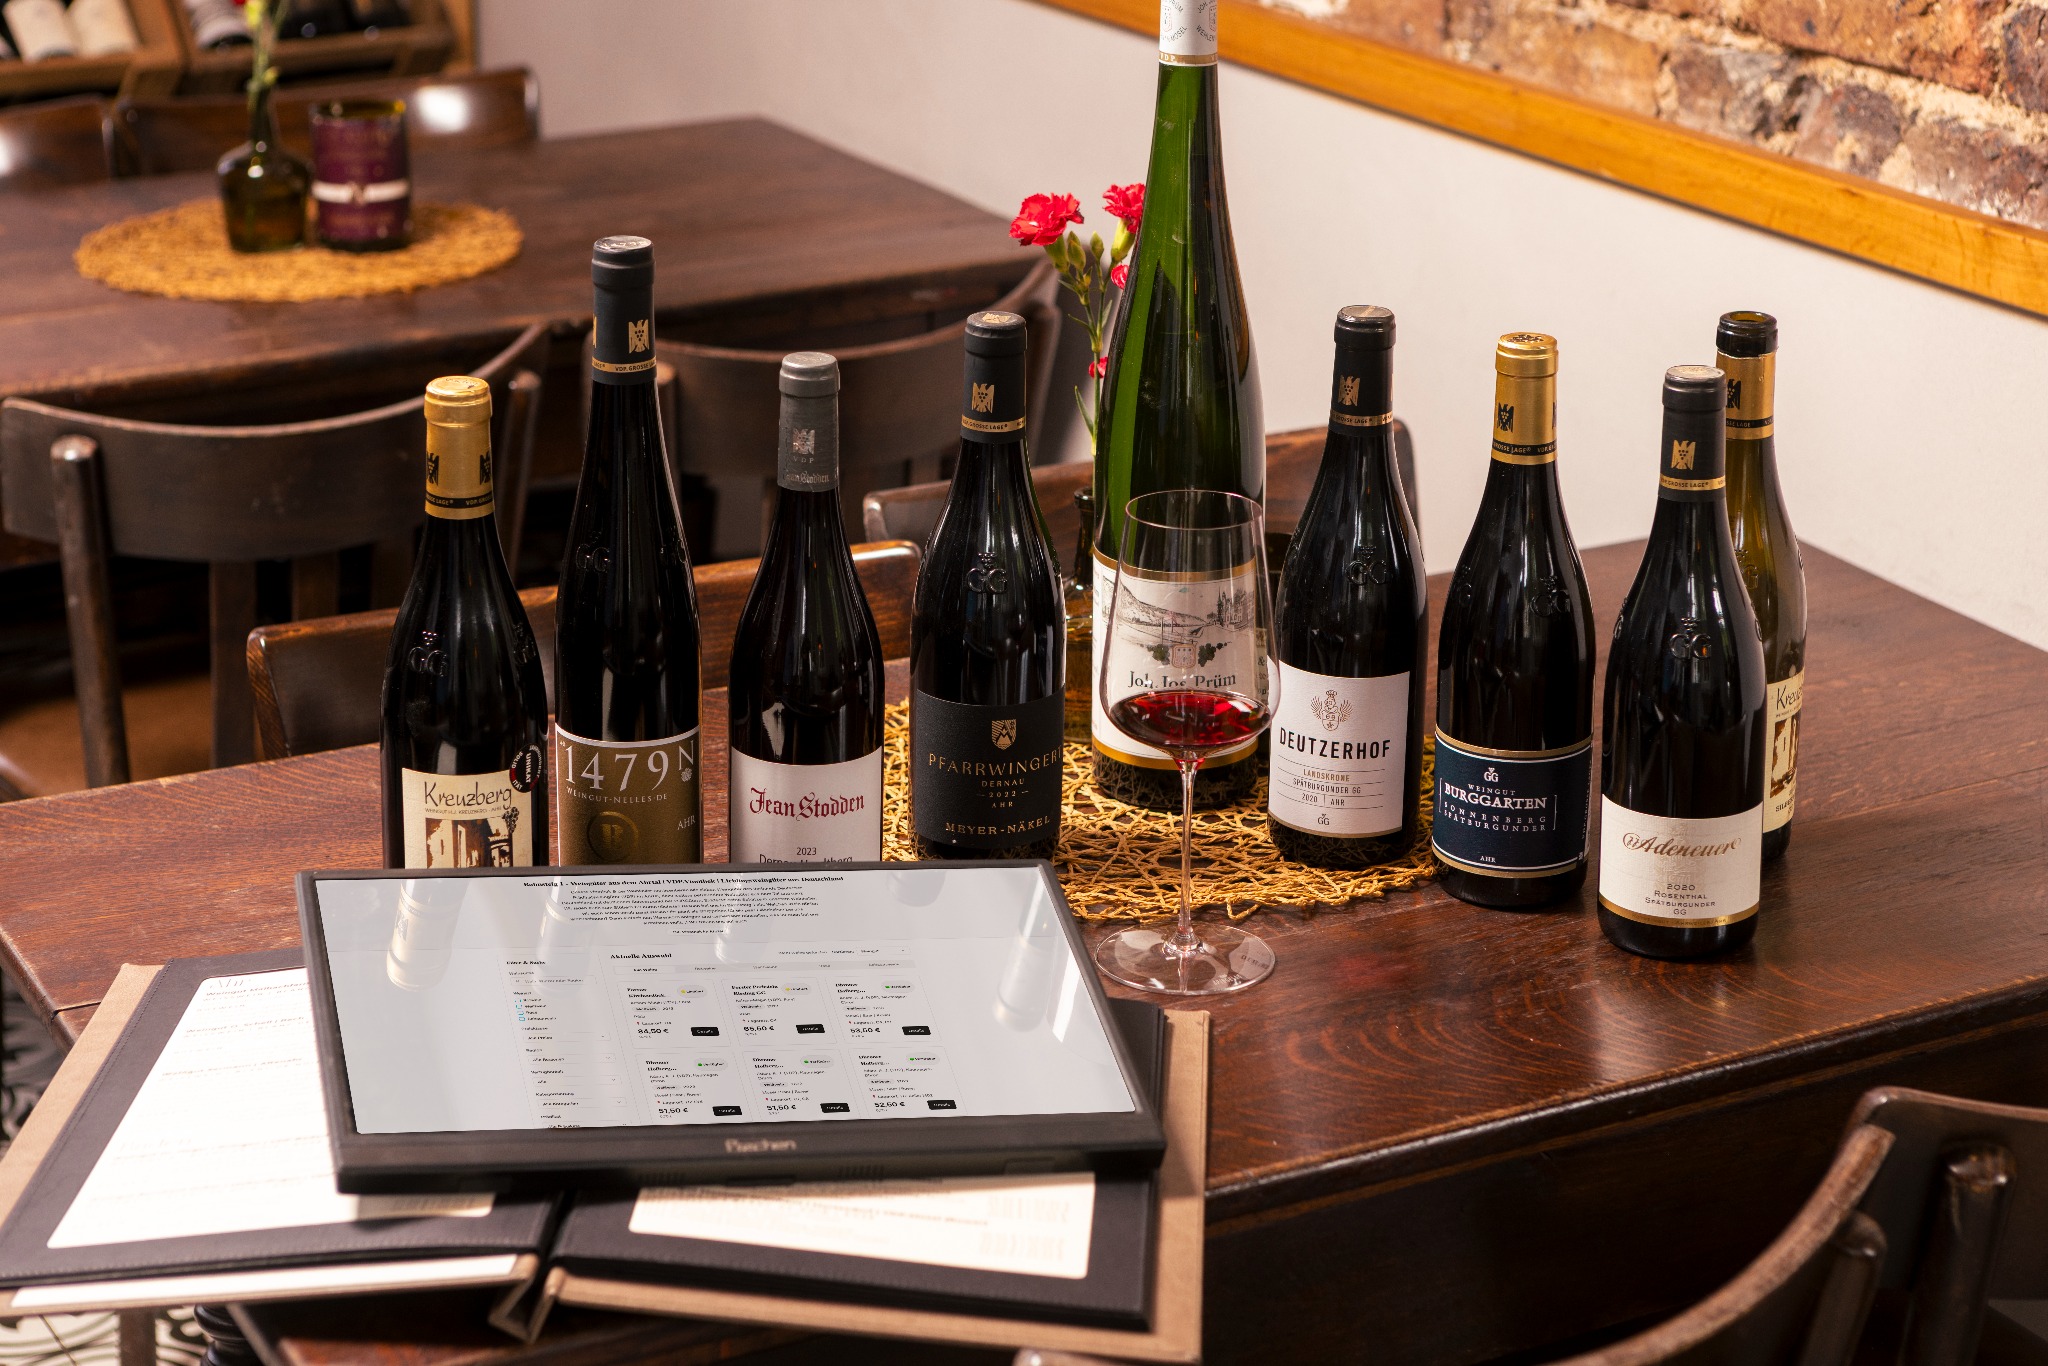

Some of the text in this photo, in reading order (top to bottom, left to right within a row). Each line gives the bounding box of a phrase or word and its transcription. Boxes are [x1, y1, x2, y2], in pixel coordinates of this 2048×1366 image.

[1195, 673, 1236, 689] Prüm
[1280, 726, 1391, 760] DEUTZERHOF
[565, 745, 669, 792] 1479
[929, 748, 1063, 776] PFARRWINGERT
[1303, 768, 1350, 782] LANDSKRONE
[981, 778, 1025, 788] DERNAU
[1292, 777, 1361, 794] SPÄTBURGUNDER GG
[1467, 783, 1516, 796] WEINGUT
[424, 781, 512, 811] Kreuzberg
[988, 790, 1017, 798] 2022
[1301, 792, 1318, 803] 2020
[1444, 782, 1548, 810] BURGGARTEN
[749, 786, 865, 822] Jean Stodden
[991, 801, 1014, 809] AHR
[1330, 798, 1345, 806] AHR
[1444, 801, 1546, 824] SONNENBERG
[677, 814, 696, 831] AHR
[1317, 816, 1330, 826] GG
[796, 847, 817, 856] 2023
[1480, 855, 1497, 864] AHR
[1666, 883, 1696, 891] 2020
[1673, 908, 1687, 916] GG
